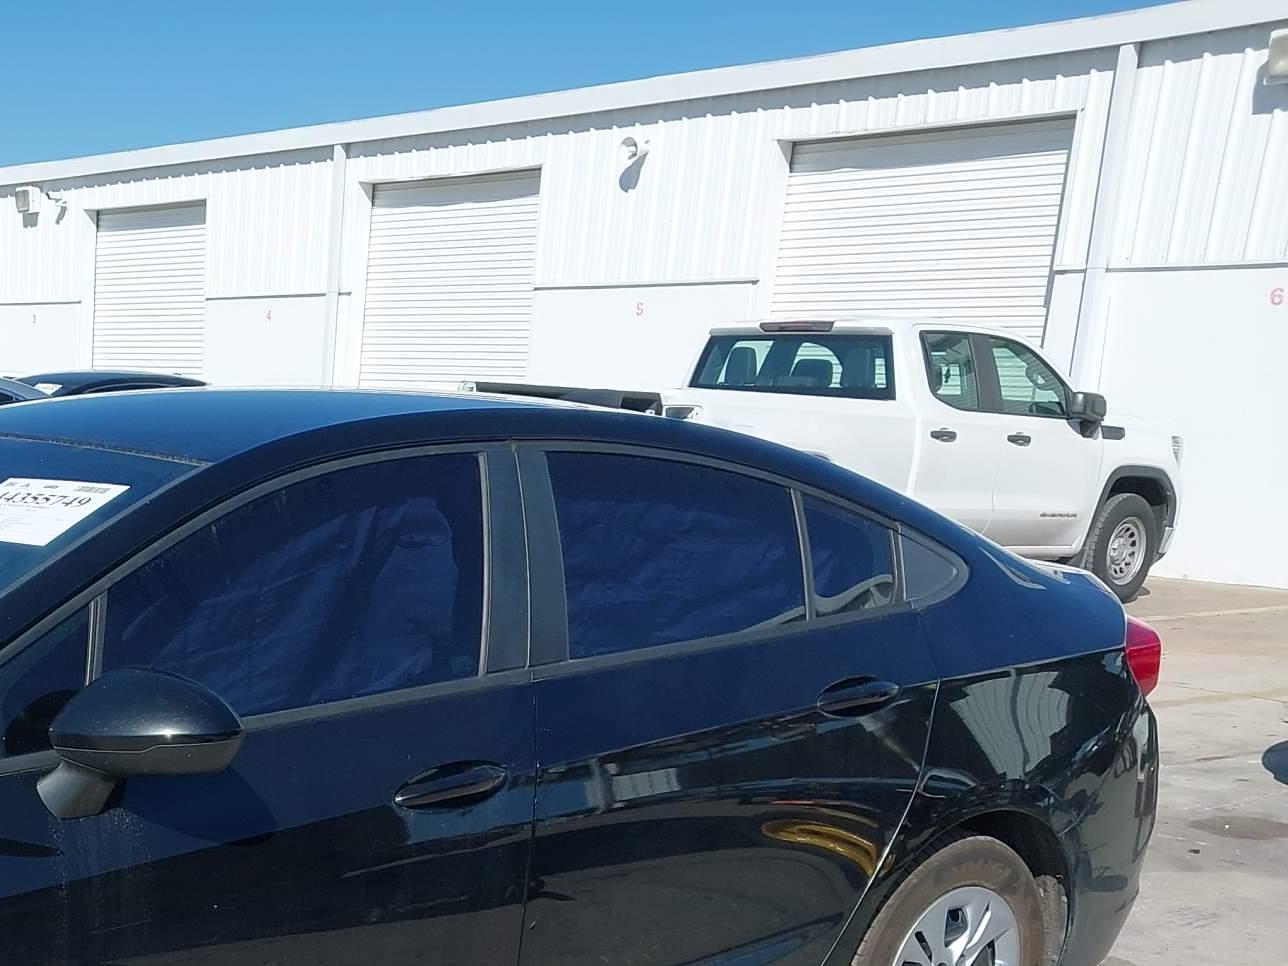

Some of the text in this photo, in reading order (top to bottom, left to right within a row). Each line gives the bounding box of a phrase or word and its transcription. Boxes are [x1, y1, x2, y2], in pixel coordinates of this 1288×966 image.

[1270, 288, 1285, 306] 6
[266, 309, 272, 321] 4
[636, 302, 644, 316] 5
